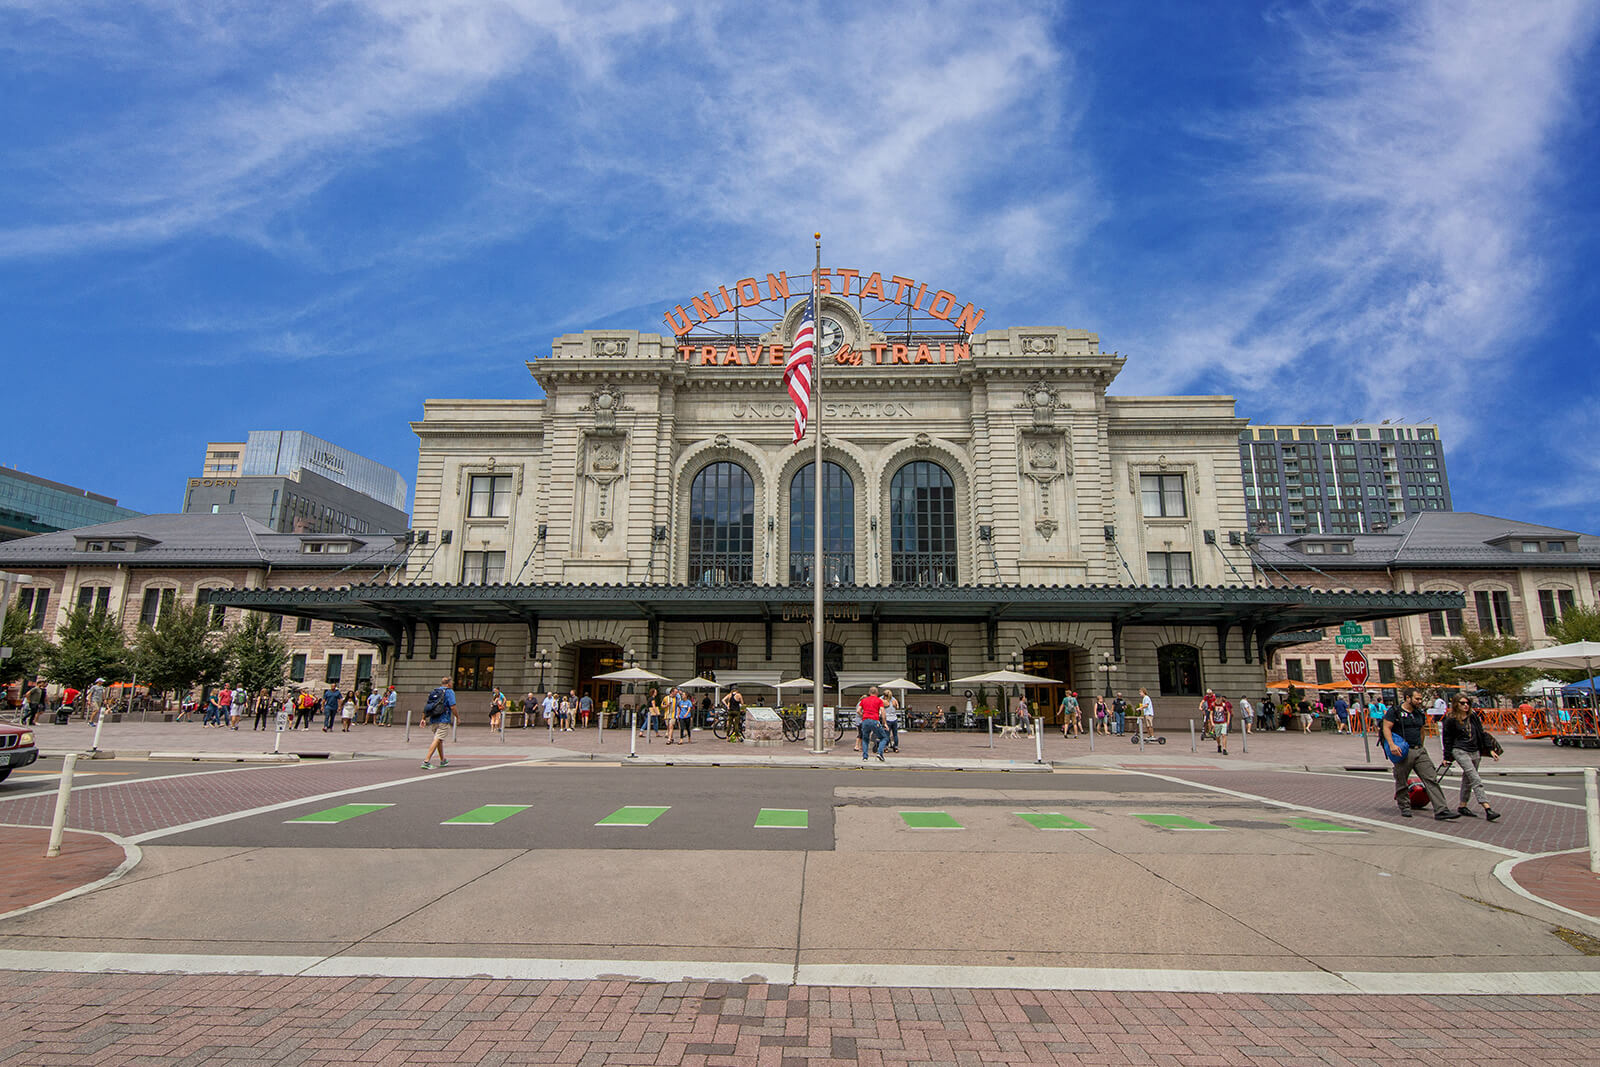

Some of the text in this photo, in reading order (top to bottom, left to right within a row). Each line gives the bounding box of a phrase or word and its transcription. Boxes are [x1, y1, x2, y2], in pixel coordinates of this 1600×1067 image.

[664, 268, 986, 337] UNION STATION
[678, 343, 970, 366] TRAVE by TRAIN
[732, 403, 914, 418] UNION STATION
[190, 479, 239, 488] BORN
[783, 602, 860, 622] CRAFORD
[1345, 661, 1365, 675] STOP
